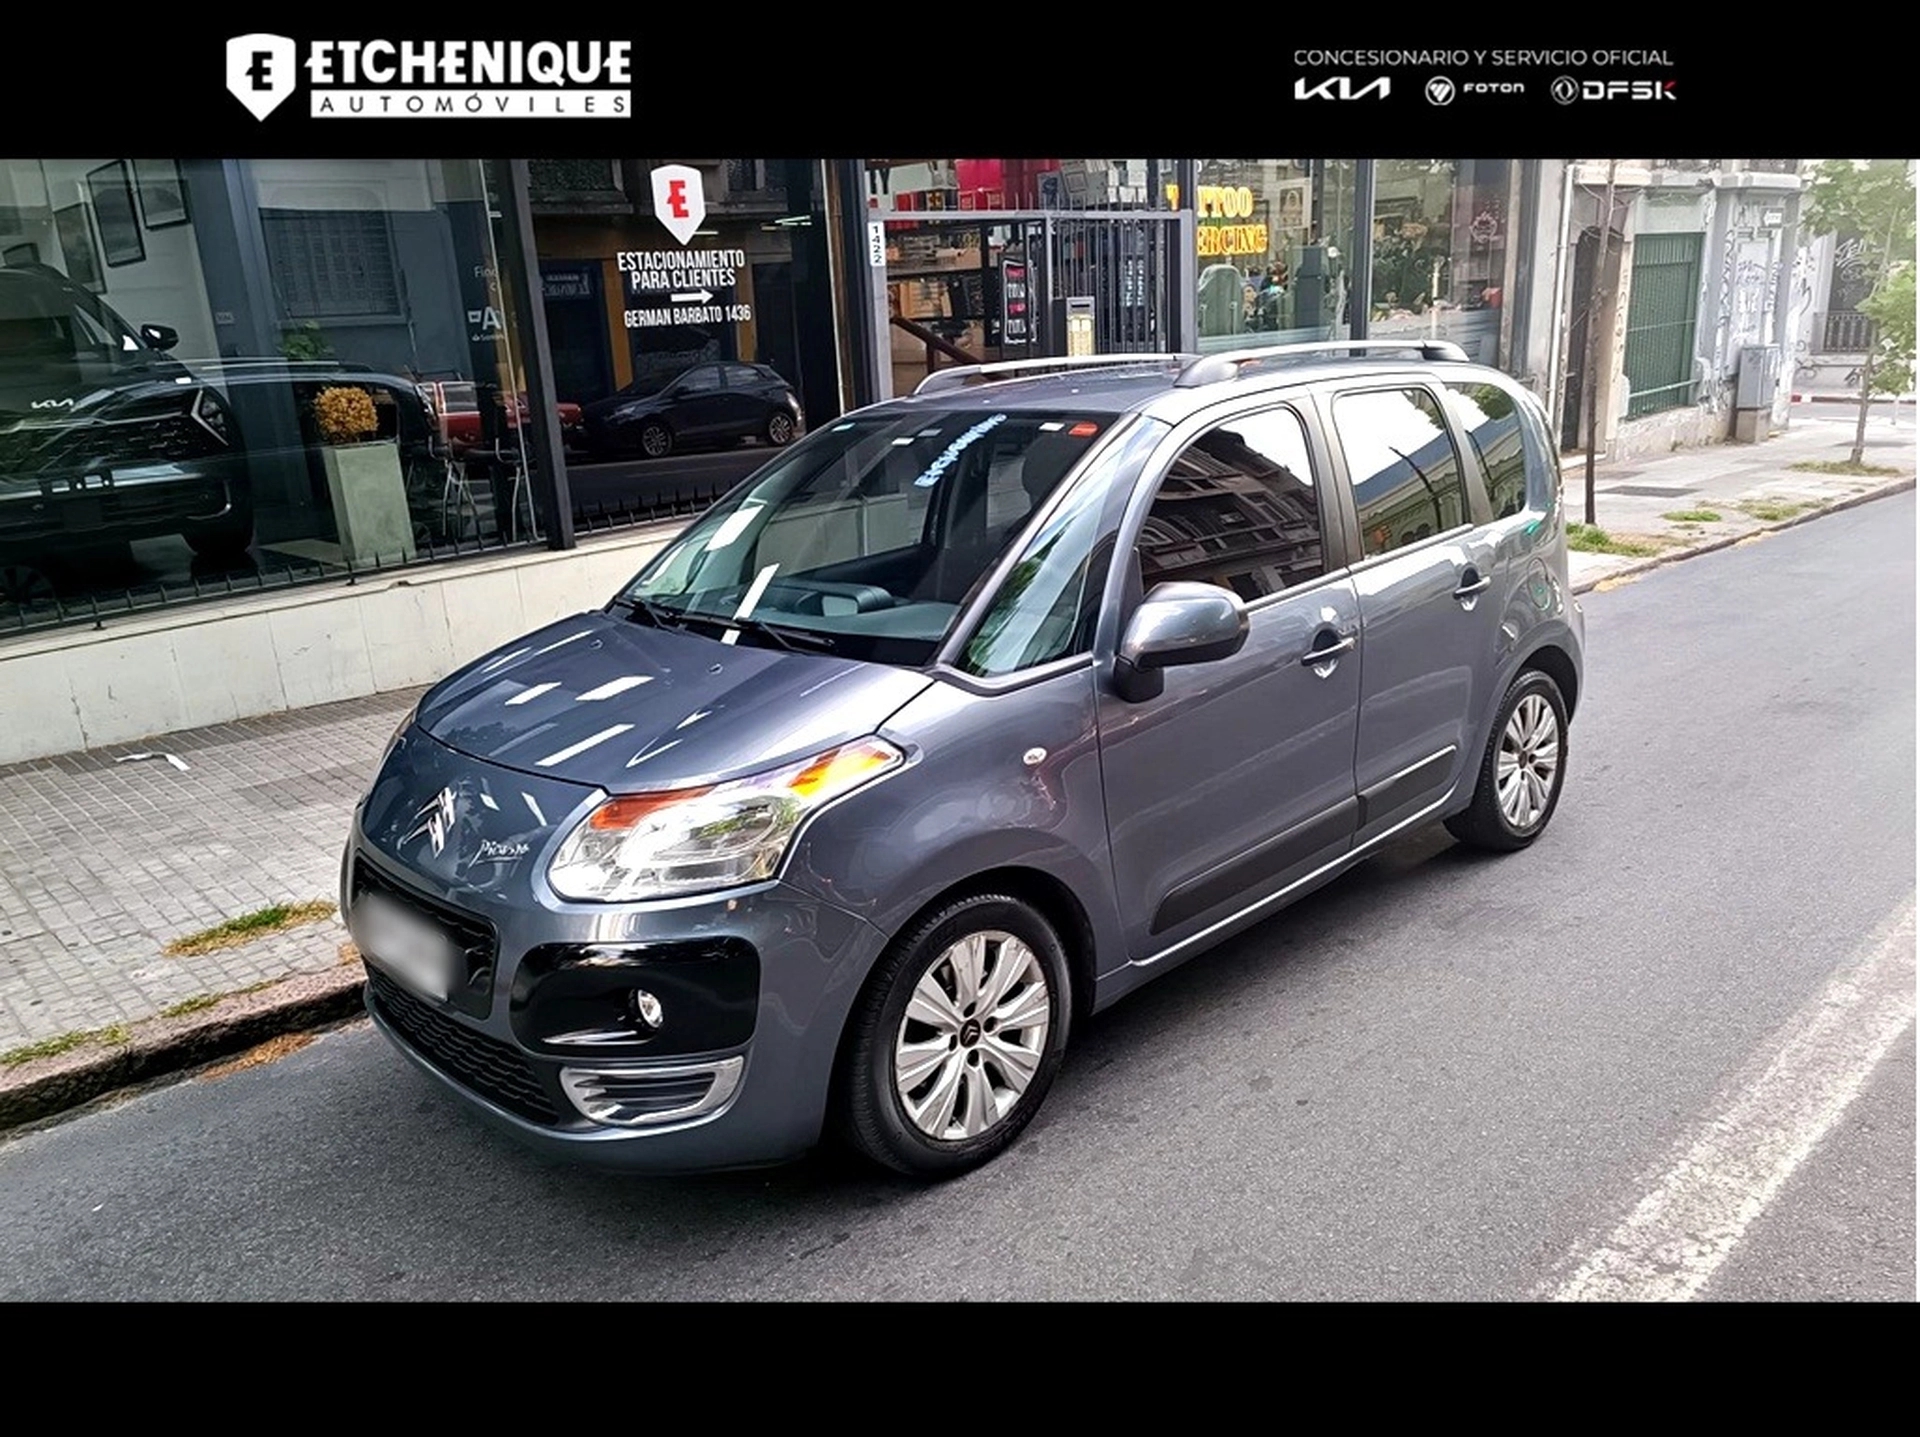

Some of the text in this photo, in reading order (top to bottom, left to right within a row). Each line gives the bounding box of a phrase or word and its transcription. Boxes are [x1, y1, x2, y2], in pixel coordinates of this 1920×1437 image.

[872, 225, 883, 264] 1422
[617, 249, 745, 271] ESTACIONAMIENTO
[631, 268, 736, 290] PARA CLIENTES
[624, 304, 751, 328] GERMAN BARBATO 1436
